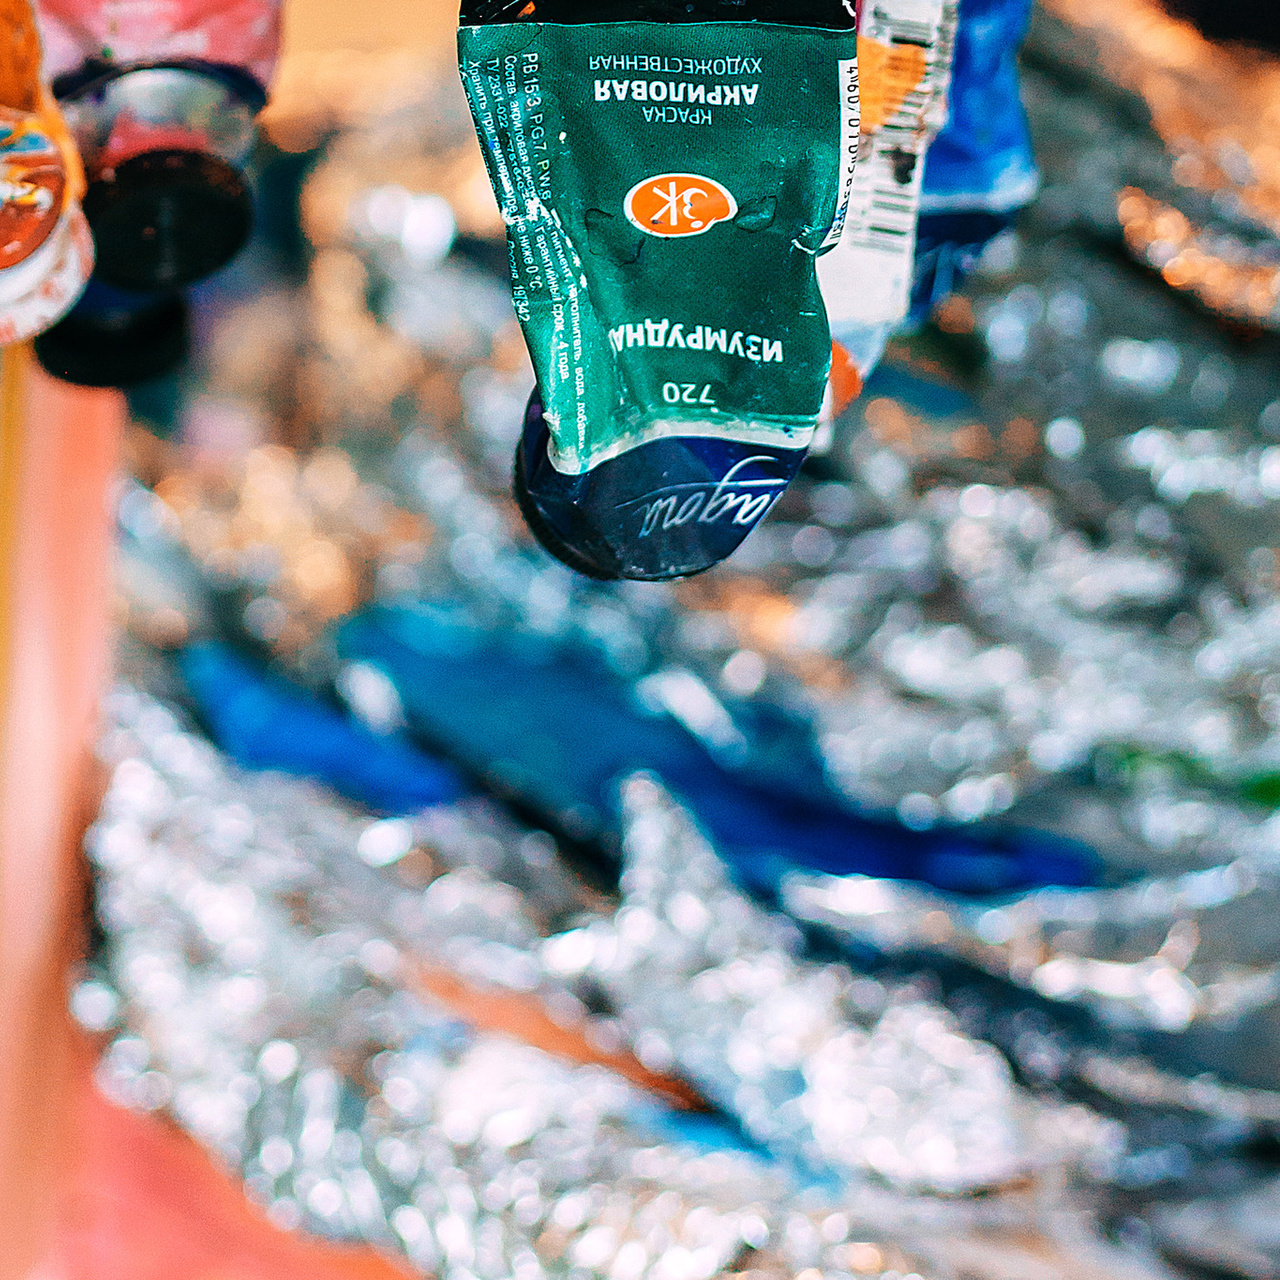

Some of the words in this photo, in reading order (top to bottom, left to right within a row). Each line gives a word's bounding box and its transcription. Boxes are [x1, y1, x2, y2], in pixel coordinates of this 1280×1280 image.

[485, 57, 499, 72] ТУ
[587, 53, 763, 74] ХУДОЖЕСТВЕННАЯ
[503, 54, 518, 98] Состав:
[592, 78, 759, 106] АКРИЛОВАЯ
[640, 105, 712, 125] КРАСКА
[467, 59, 491, 109] Хранить
[518, 235, 534, 264] ниже
[550, 303, 565, 331] срок
[556, 340, 569, 350] 4
[662, 380, 715, 404] 720
